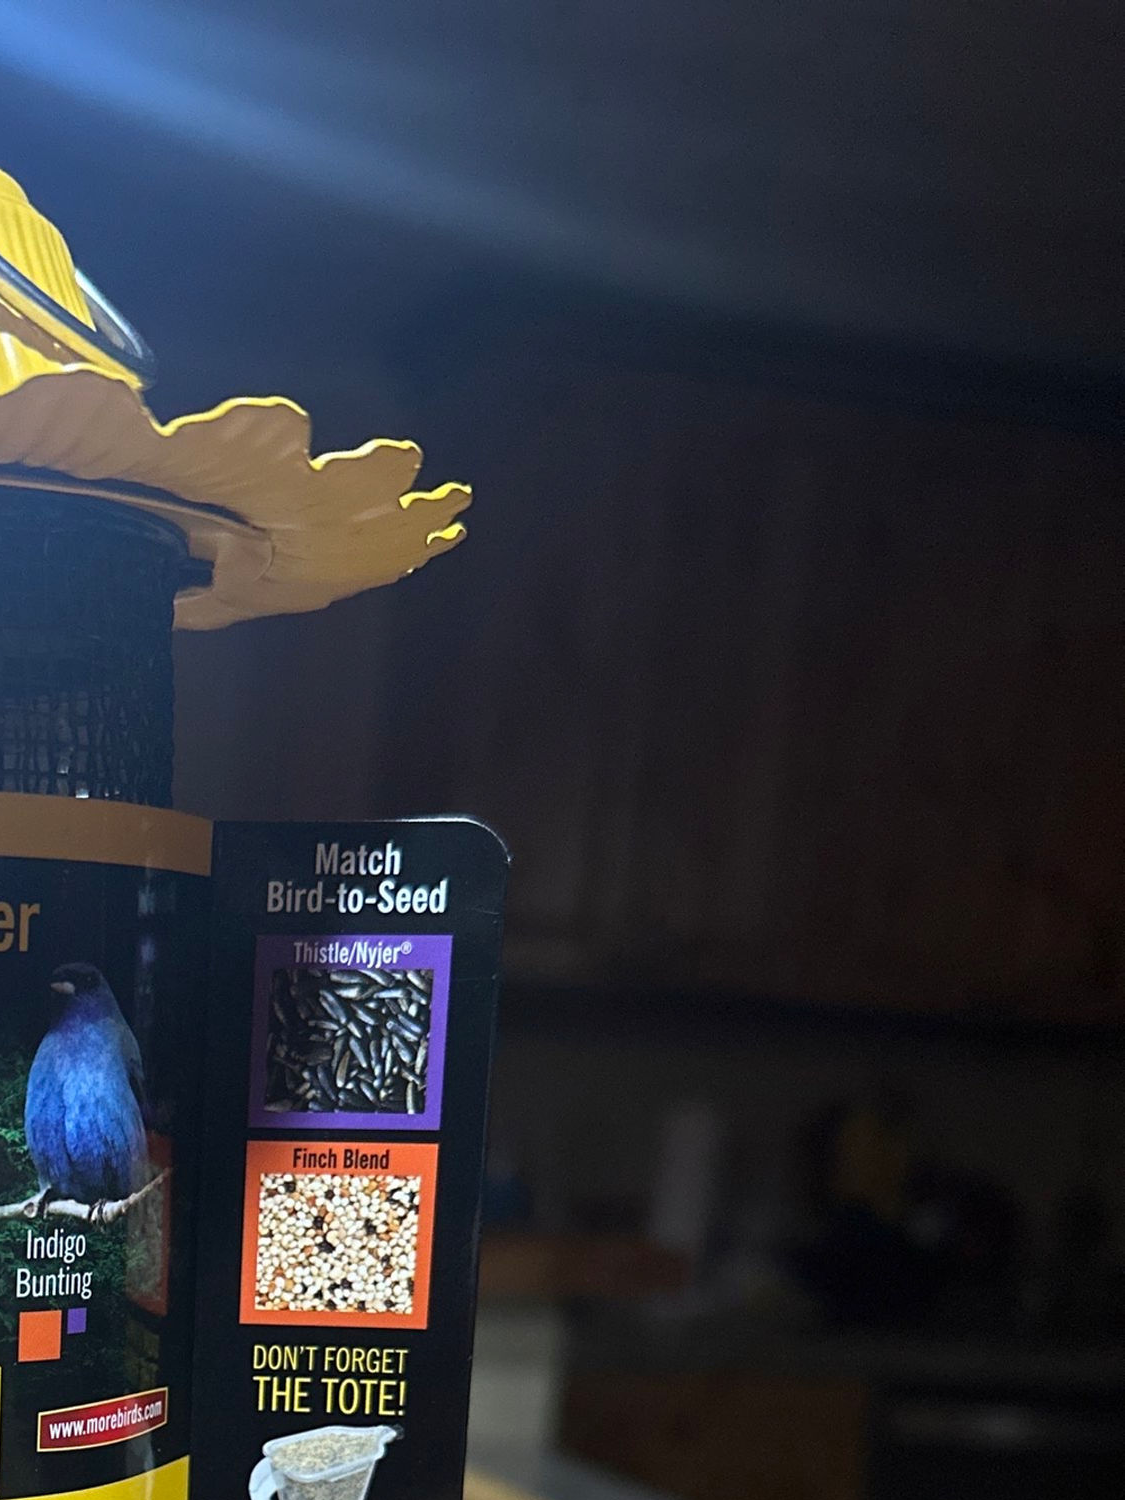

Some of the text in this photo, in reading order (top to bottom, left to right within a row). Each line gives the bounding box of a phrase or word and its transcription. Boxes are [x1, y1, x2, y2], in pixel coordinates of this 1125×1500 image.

[315, 839, 403, 876] Match
[266, 878, 449, 914] Bird-to-Seed
[291, 1148, 391, 1171] Finch Blend
[26, 1228, 87, 1264] Indigo
[16, 1266, 94, 1300] Bunting
[252, 1344, 409, 1374] DON'T FORGET
[253, 1375, 407, 1416] THE TOTE!
[48, 1400, 163, 1440] www.morebirds.com
